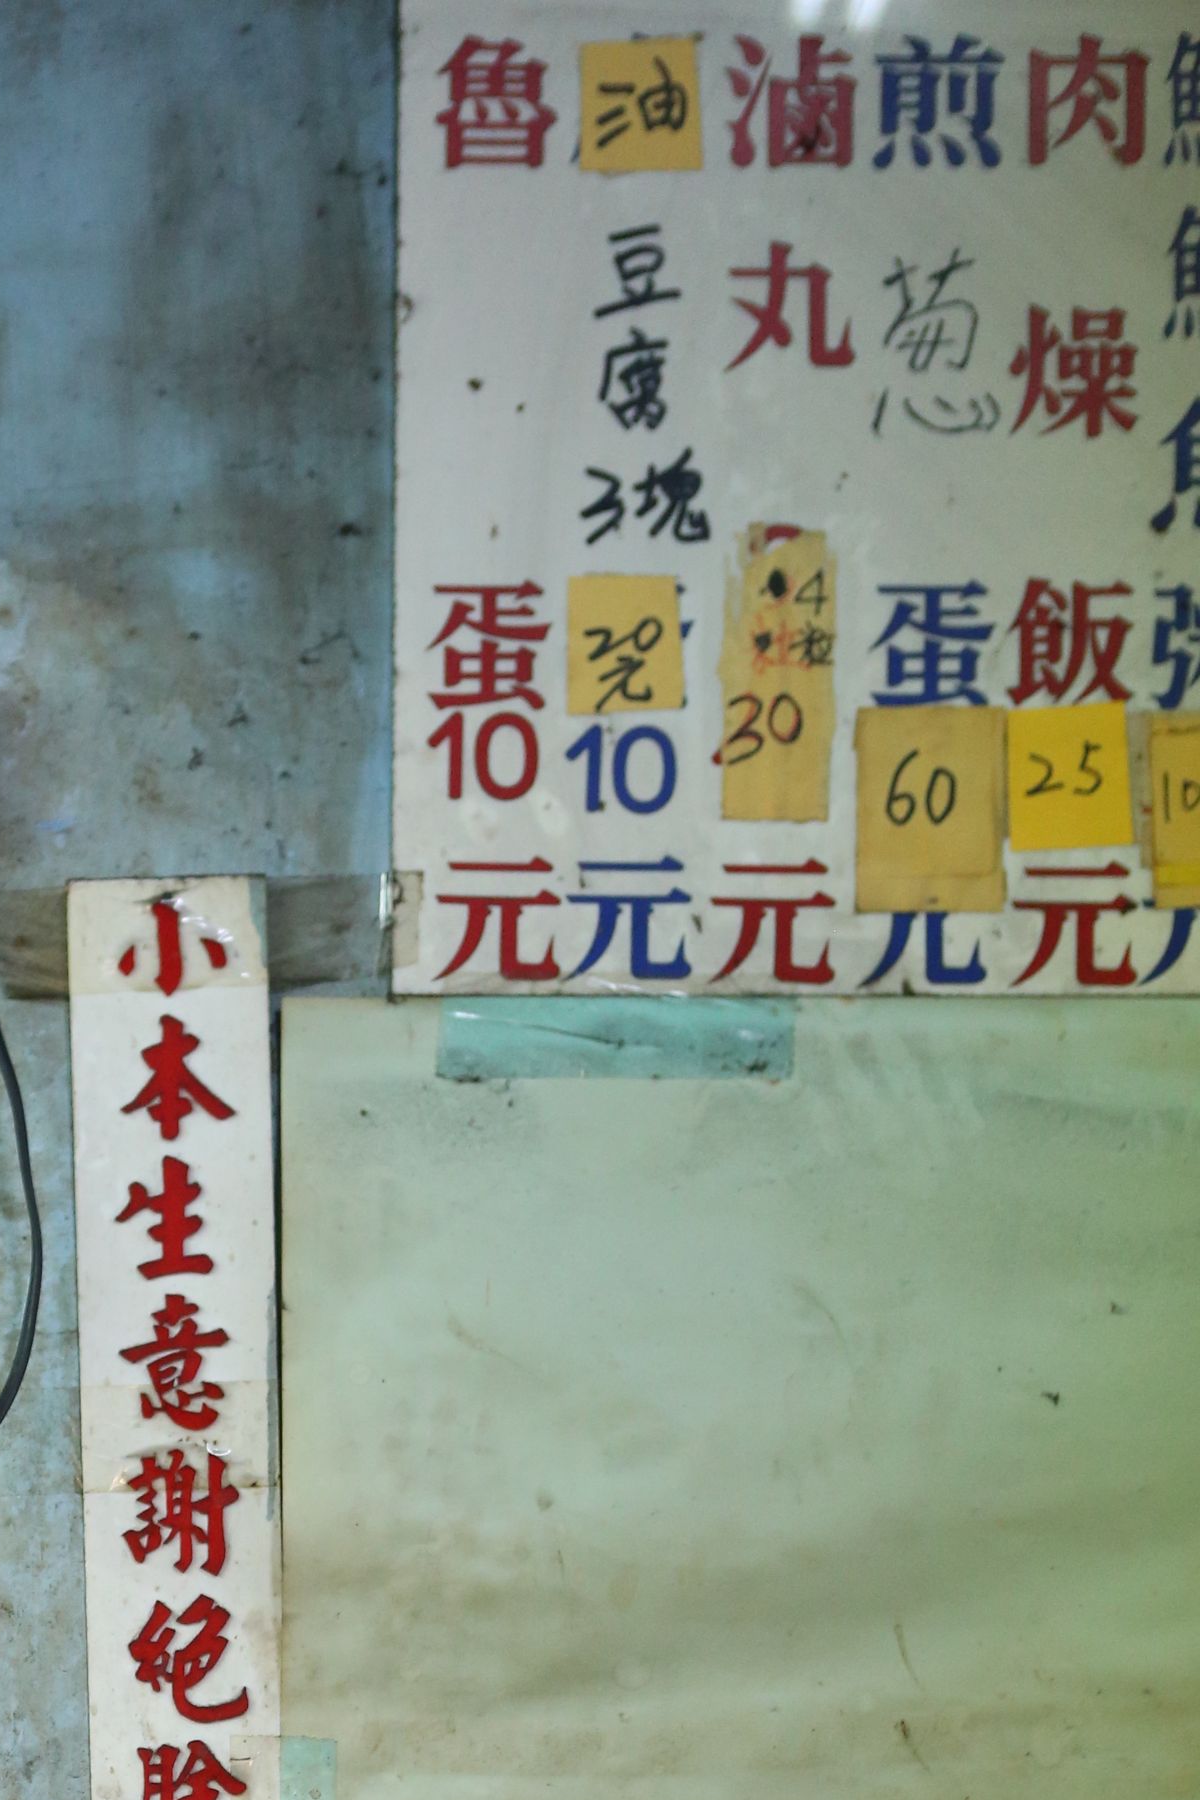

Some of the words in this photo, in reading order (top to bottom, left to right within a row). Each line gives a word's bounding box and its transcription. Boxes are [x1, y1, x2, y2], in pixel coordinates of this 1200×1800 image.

[584, 617, 663, 662] 20
[427, 711, 540, 802] 10
[565, 722, 680, 816] 10
[885, 749, 959, 827] 60
[1026, 743, 1103, 796] 25
[436, 856, 561, 982] 元
[566, 854, 693, 982] 元
[710, 857, 836, 985] 元
[1011, 862, 1139, 987] 元
